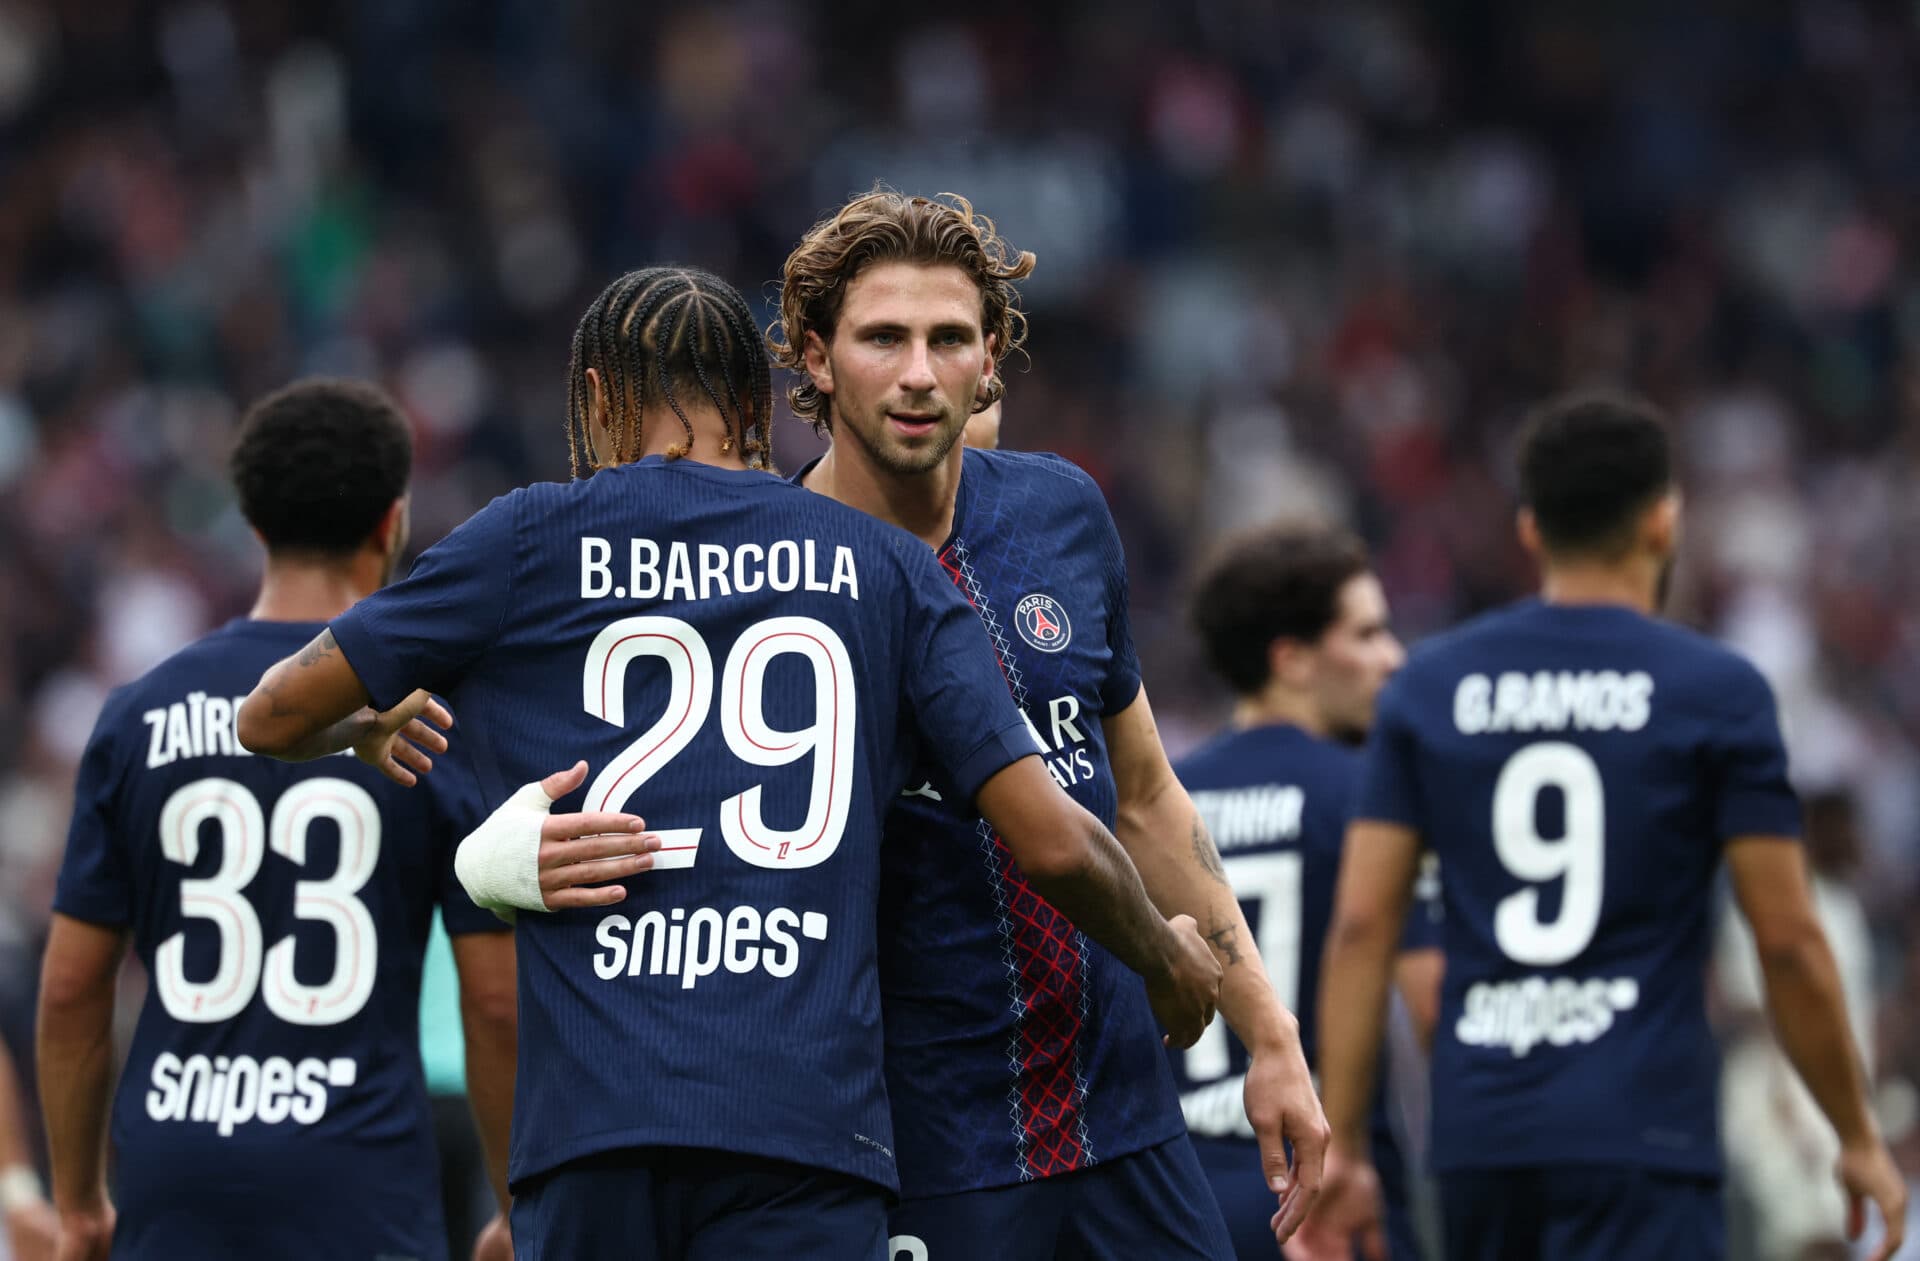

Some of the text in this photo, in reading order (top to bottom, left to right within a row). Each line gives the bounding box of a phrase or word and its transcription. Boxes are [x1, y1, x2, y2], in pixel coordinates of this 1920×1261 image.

[581, 536, 859, 601] B.BARCOLA
[1019, 597, 1053, 615] PARIS
[582, 615, 856, 870] 29
[1453, 670, 1654, 734] G.RAMOS
[1493, 742, 1605, 966] 9
[155, 777, 382, 1026] 33
[594, 906, 802, 990] snipes
[146, 1051, 328, 1137] snipes
